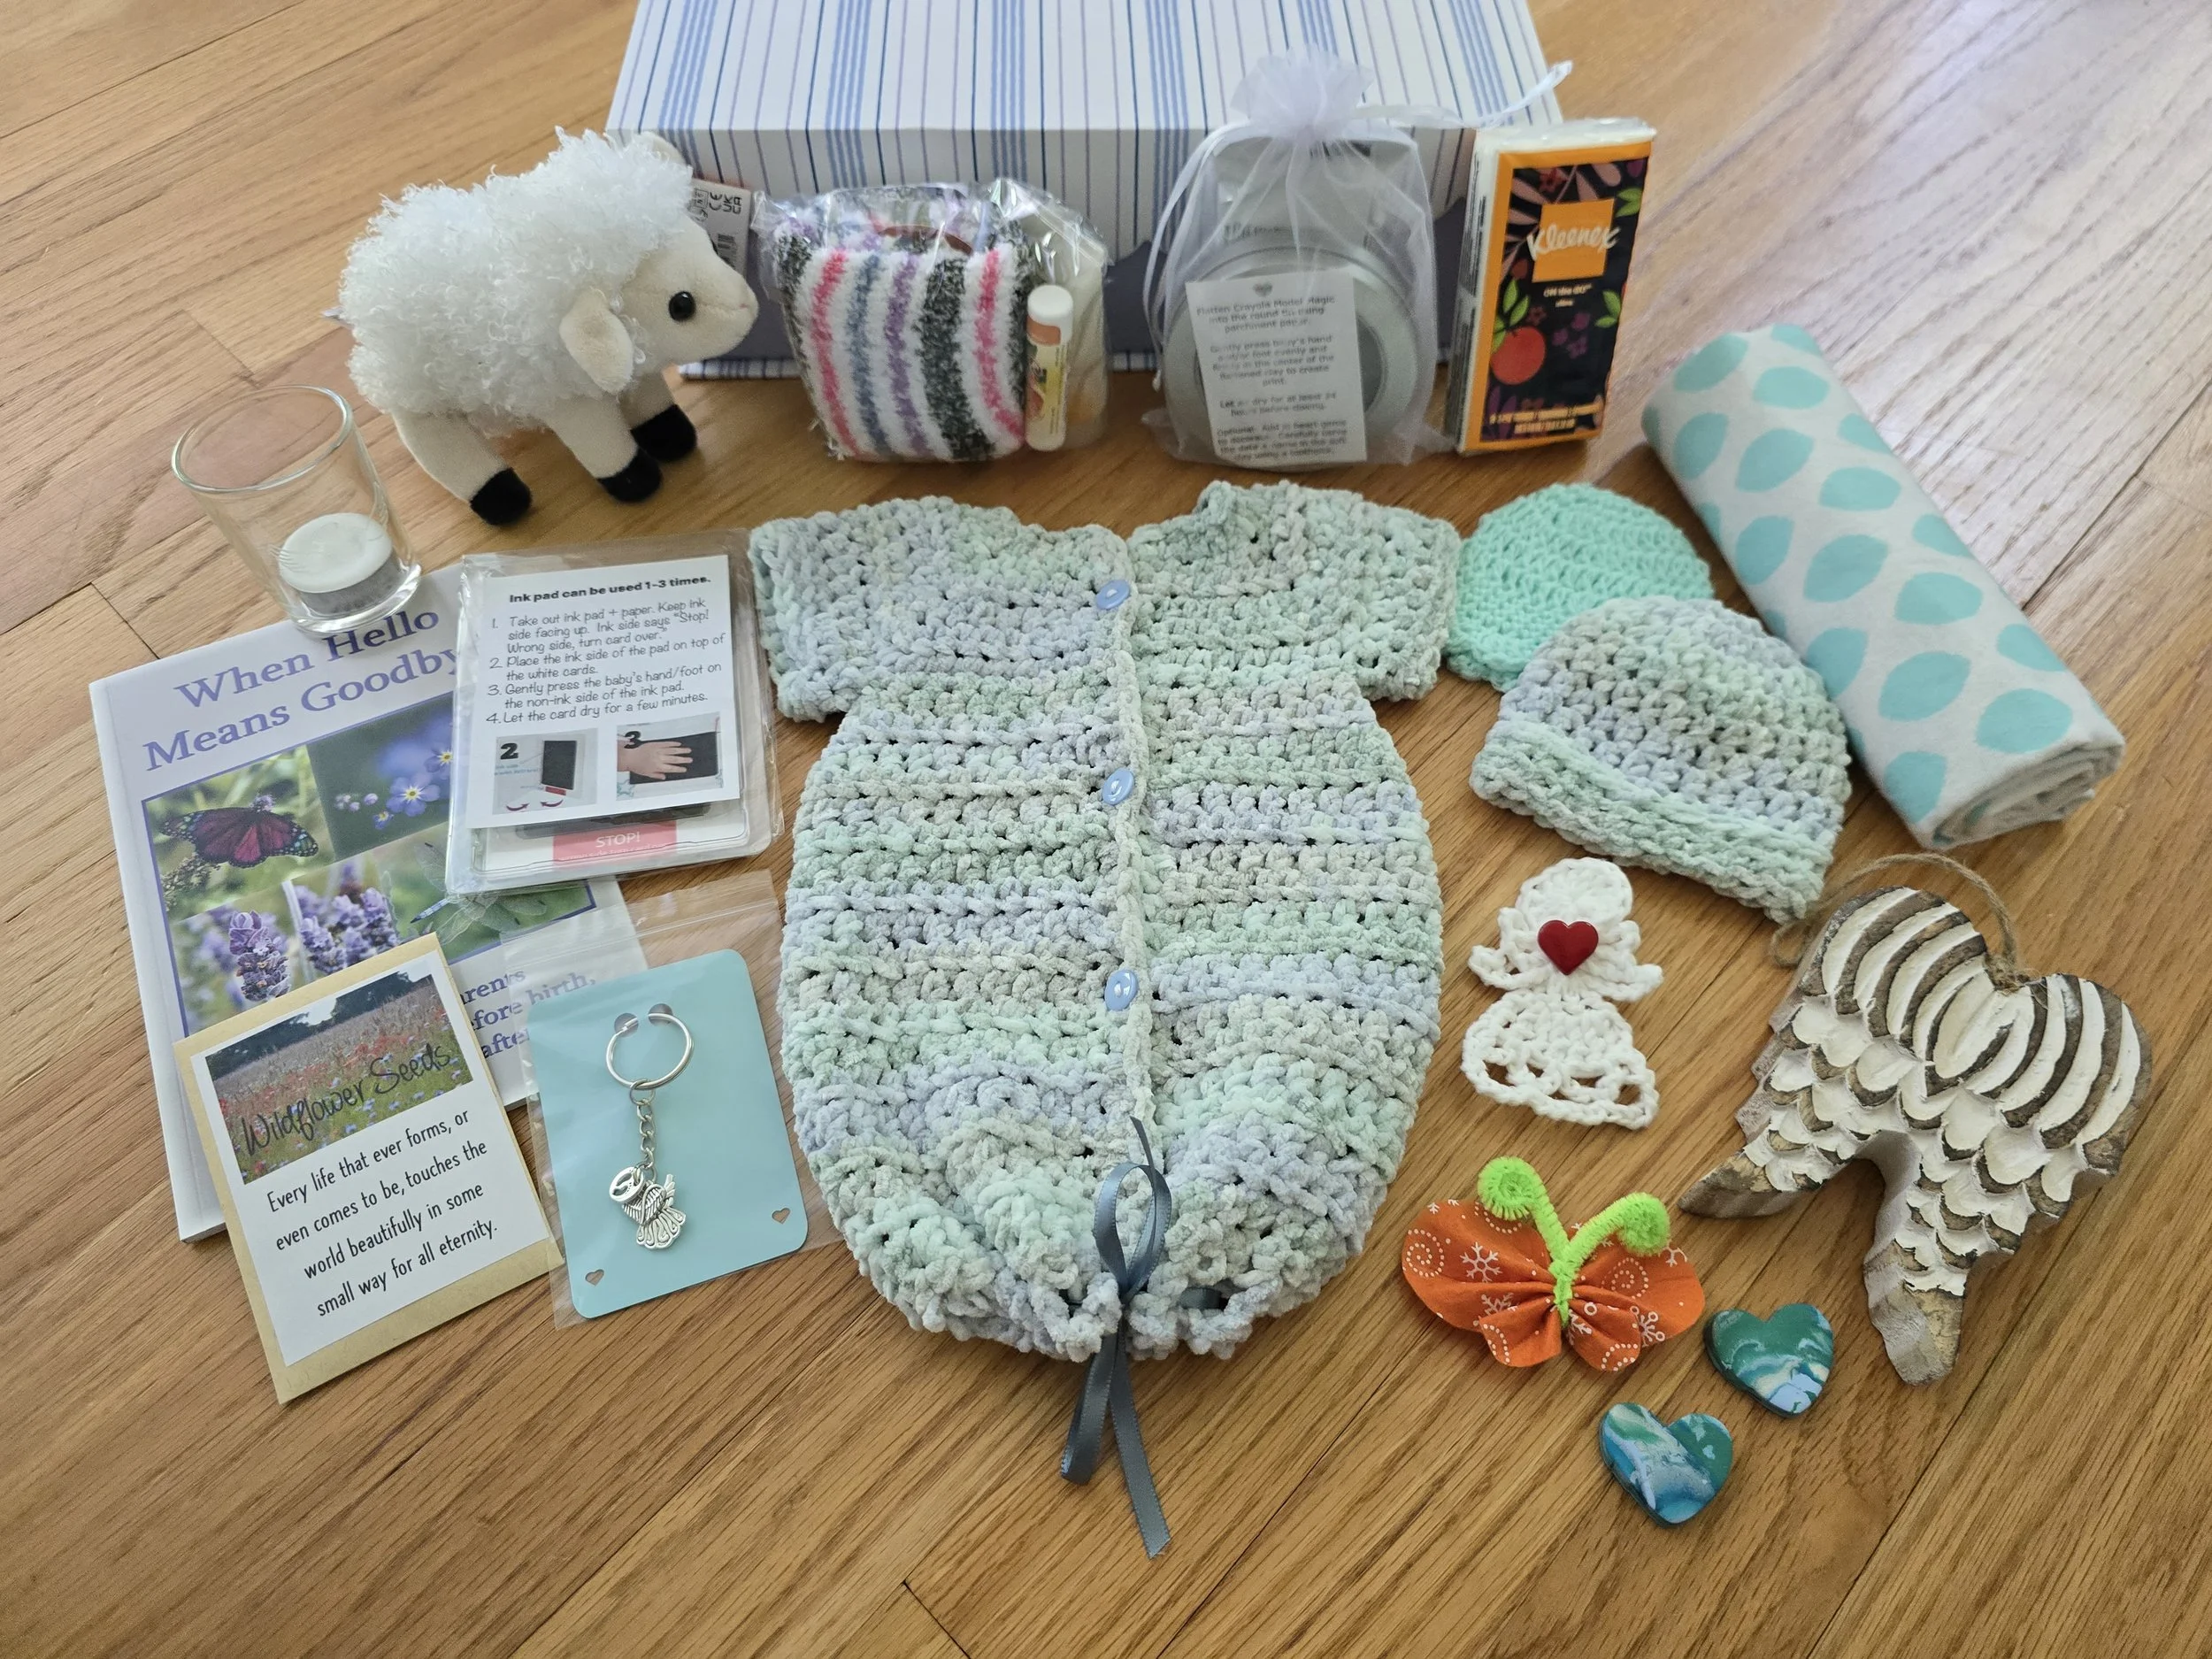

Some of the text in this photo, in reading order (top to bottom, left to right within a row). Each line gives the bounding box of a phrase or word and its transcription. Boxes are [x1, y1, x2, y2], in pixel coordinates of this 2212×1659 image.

[1526, 222, 1621, 261] Kleenex
[1231, 313, 1247, 323] the
[1249, 310, 1279, 320] round
[1233, 301, 1271, 312] Crayola
[1273, 297, 1302, 308] Model
[1224, 320, 1277, 334] parchment
[510, 594, 531, 603] Ink
[534, 590, 559, 603] pad
[562, 589, 588, 599] can
[589, 587, 607, 596] be
[609, 582, 642, 594] used
[669, 576, 711, 588] times.
[510, 615, 539, 627] Take
[541, 614, 560, 625] out
[565, 611, 580, 622] ink
[584, 609, 605, 624] pad
[621, 606, 656, 619] paper.
[657, 602, 687, 614] Keep
[689, 597, 706, 609] ink
[507, 642, 545, 655] Wrong
[549, 639, 575, 651] side,
[579, 637, 603, 648] turn
[605, 633, 632, 645] card
[508, 628, 532, 641] side
[535, 627, 571, 639] facing
[573, 626, 590, 637] up.
[597, 621, 614, 632] Ink
[618, 619, 641, 631] side
[644, 617, 671, 629] says
[173, 611, 440, 709] When Hello
[506, 656, 540, 667] Place
[543, 654, 562, 665] the
[565, 651, 582, 663] ink
[586, 649, 609, 661] side
[611, 646, 626, 658] of
[628, 645, 647, 657] the
[649, 641, 670, 657] pad
[672, 641, 688, 651] on
[691, 638, 710, 650] top
[712, 633, 726, 645] of
[487, 664, 722, 696] 3. Gently press the baby's hand/foot on
[506, 670, 525, 681] the
[527, 668, 559, 680] white
[486, 693, 709, 724] 4. Let the card dry for a few minutes.
[504, 680, 685, 709] the non-ink side of the ink pad.
[142, 704, 291, 772] Means
[500, 742, 519, 760] 2
[595, 831, 641, 849] STOP!
[241, 1043, 451, 1156] Wildflower Seeds
[266, 1110, 470, 1213] Every life that ever forms, or
[276, 1140, 488, 1251] even comes to be, touches the
[303, 1183, 484, 1279] world beautifully in some
[317, 1219, 498, 1317] small way for all eternity.
